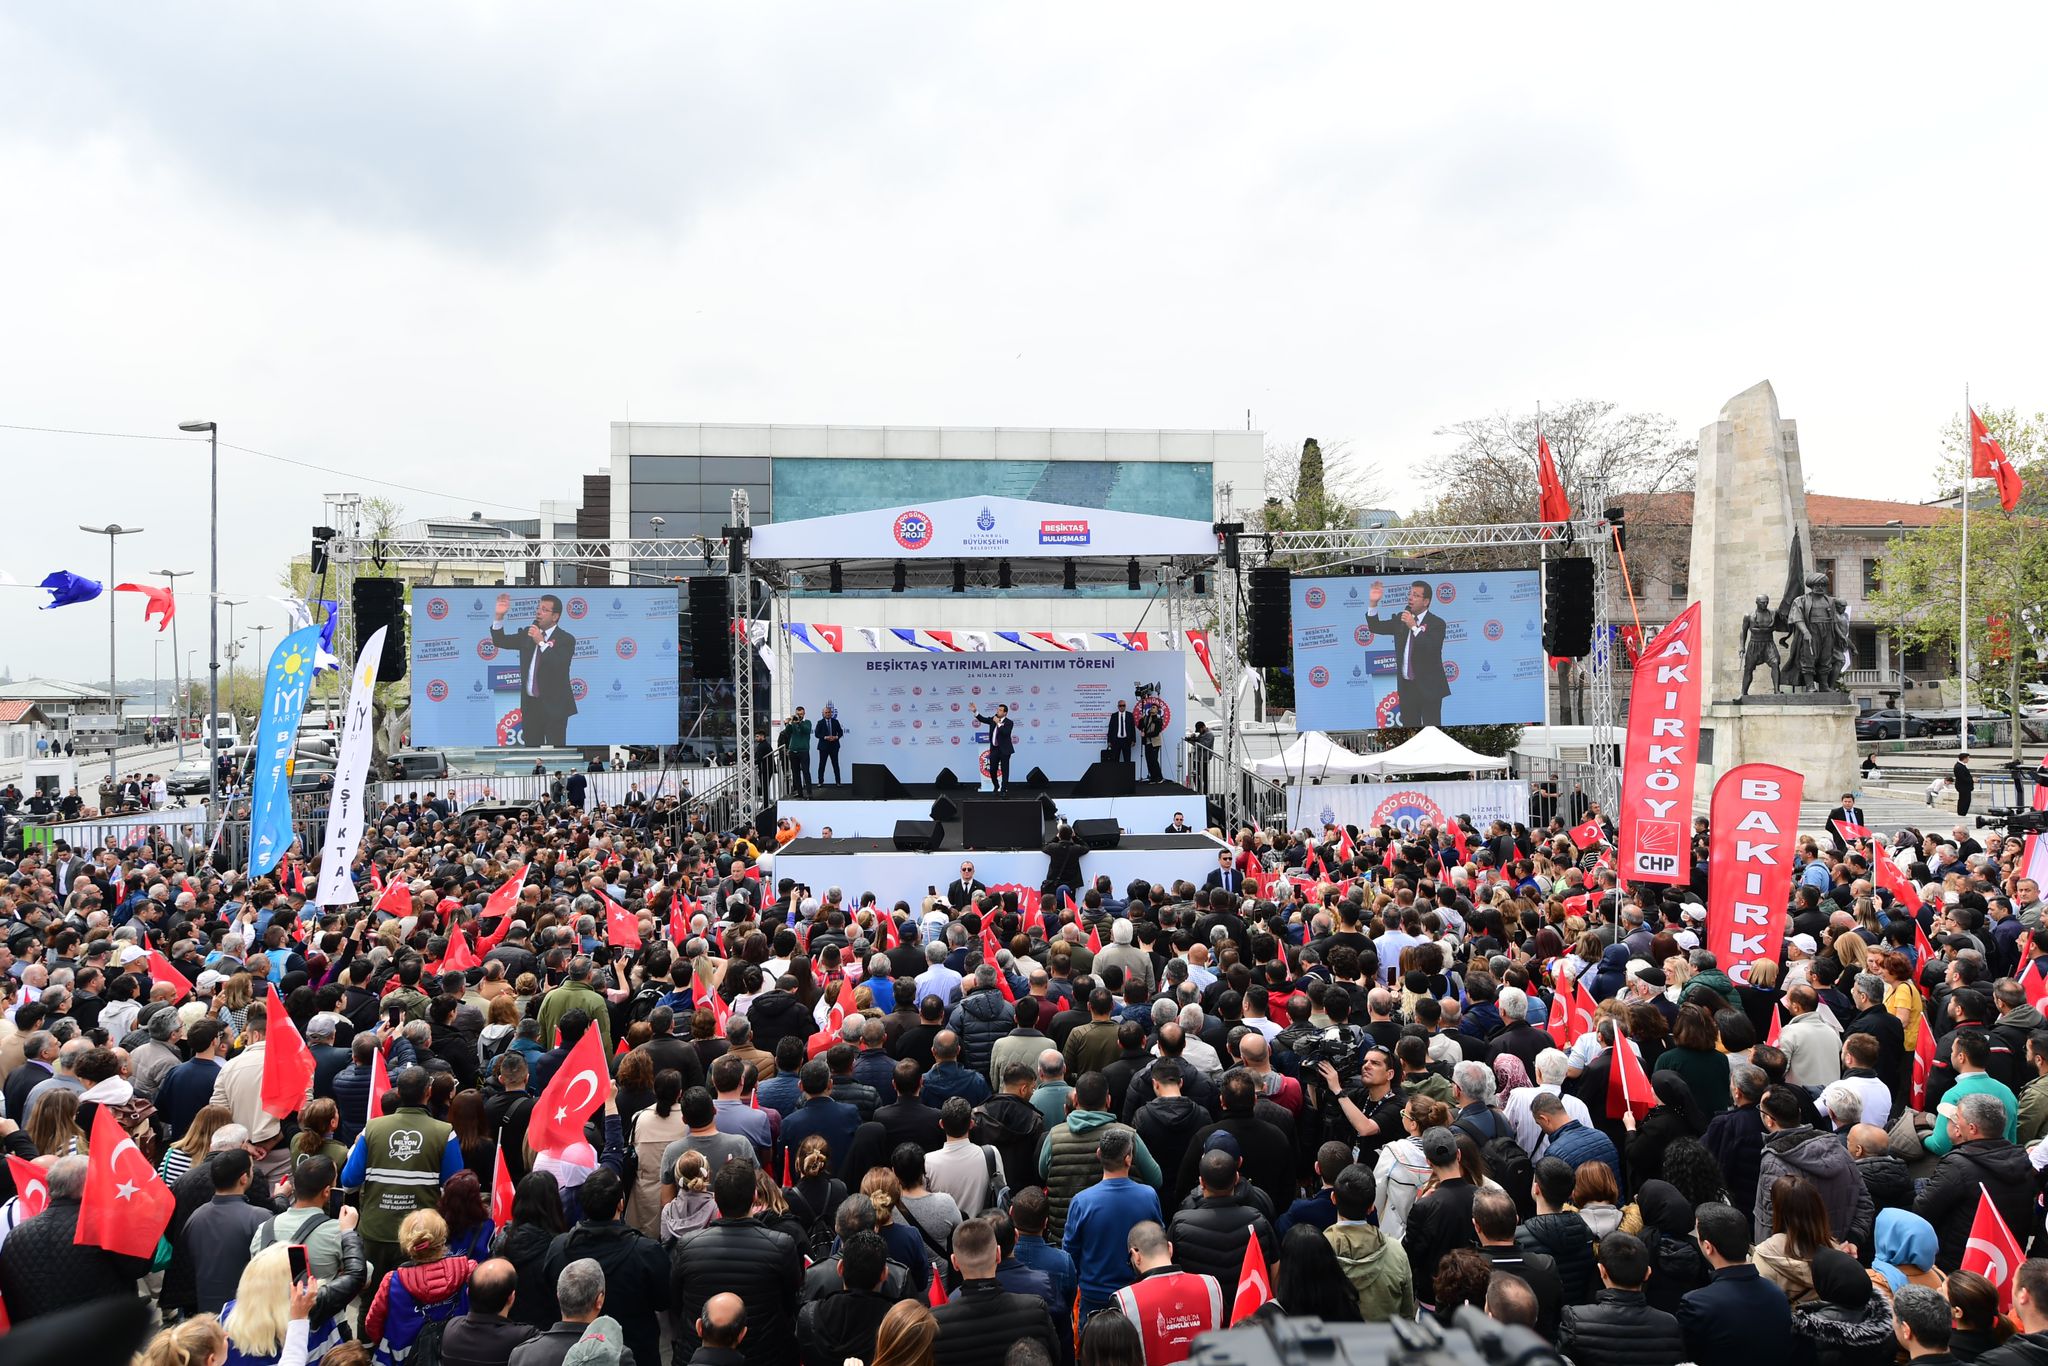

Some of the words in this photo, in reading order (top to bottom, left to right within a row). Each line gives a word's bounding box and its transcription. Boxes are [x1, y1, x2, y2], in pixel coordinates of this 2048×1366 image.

[901, 522, 926, 532] 300
[1044, 523, 1085, 533] BEŞİKTAŞ
[1043, 535, 1087, 543] BULUŞMASI
[866, 658, 928, 672] BEŞİKTAŞ
[931, 660, 1011, 670] YATIRIMLARI
[1014, 660, 1066, 669] TANITIM
[1069, 657, 1115, 669] TÖRENİ
[273, 682, 304, 715] İYİ
[272, 713, 297, 724] PART
[352, 701, 367, 732] İY
[1385, 711, 1403, 727] 30
[506, 729, 525, 746] 30
[1378, 799, 1398, 819] 300
[1399, 793, 1438, 818] GÜNDE
[1472, 805, 1502, 813] HİZMET
[1638, 855, 1675, 872] CHP
[1727, 779, 1782, 985] BAKIRKÖ
[1166, 1321, 1189, 1330] GENÇLİK
